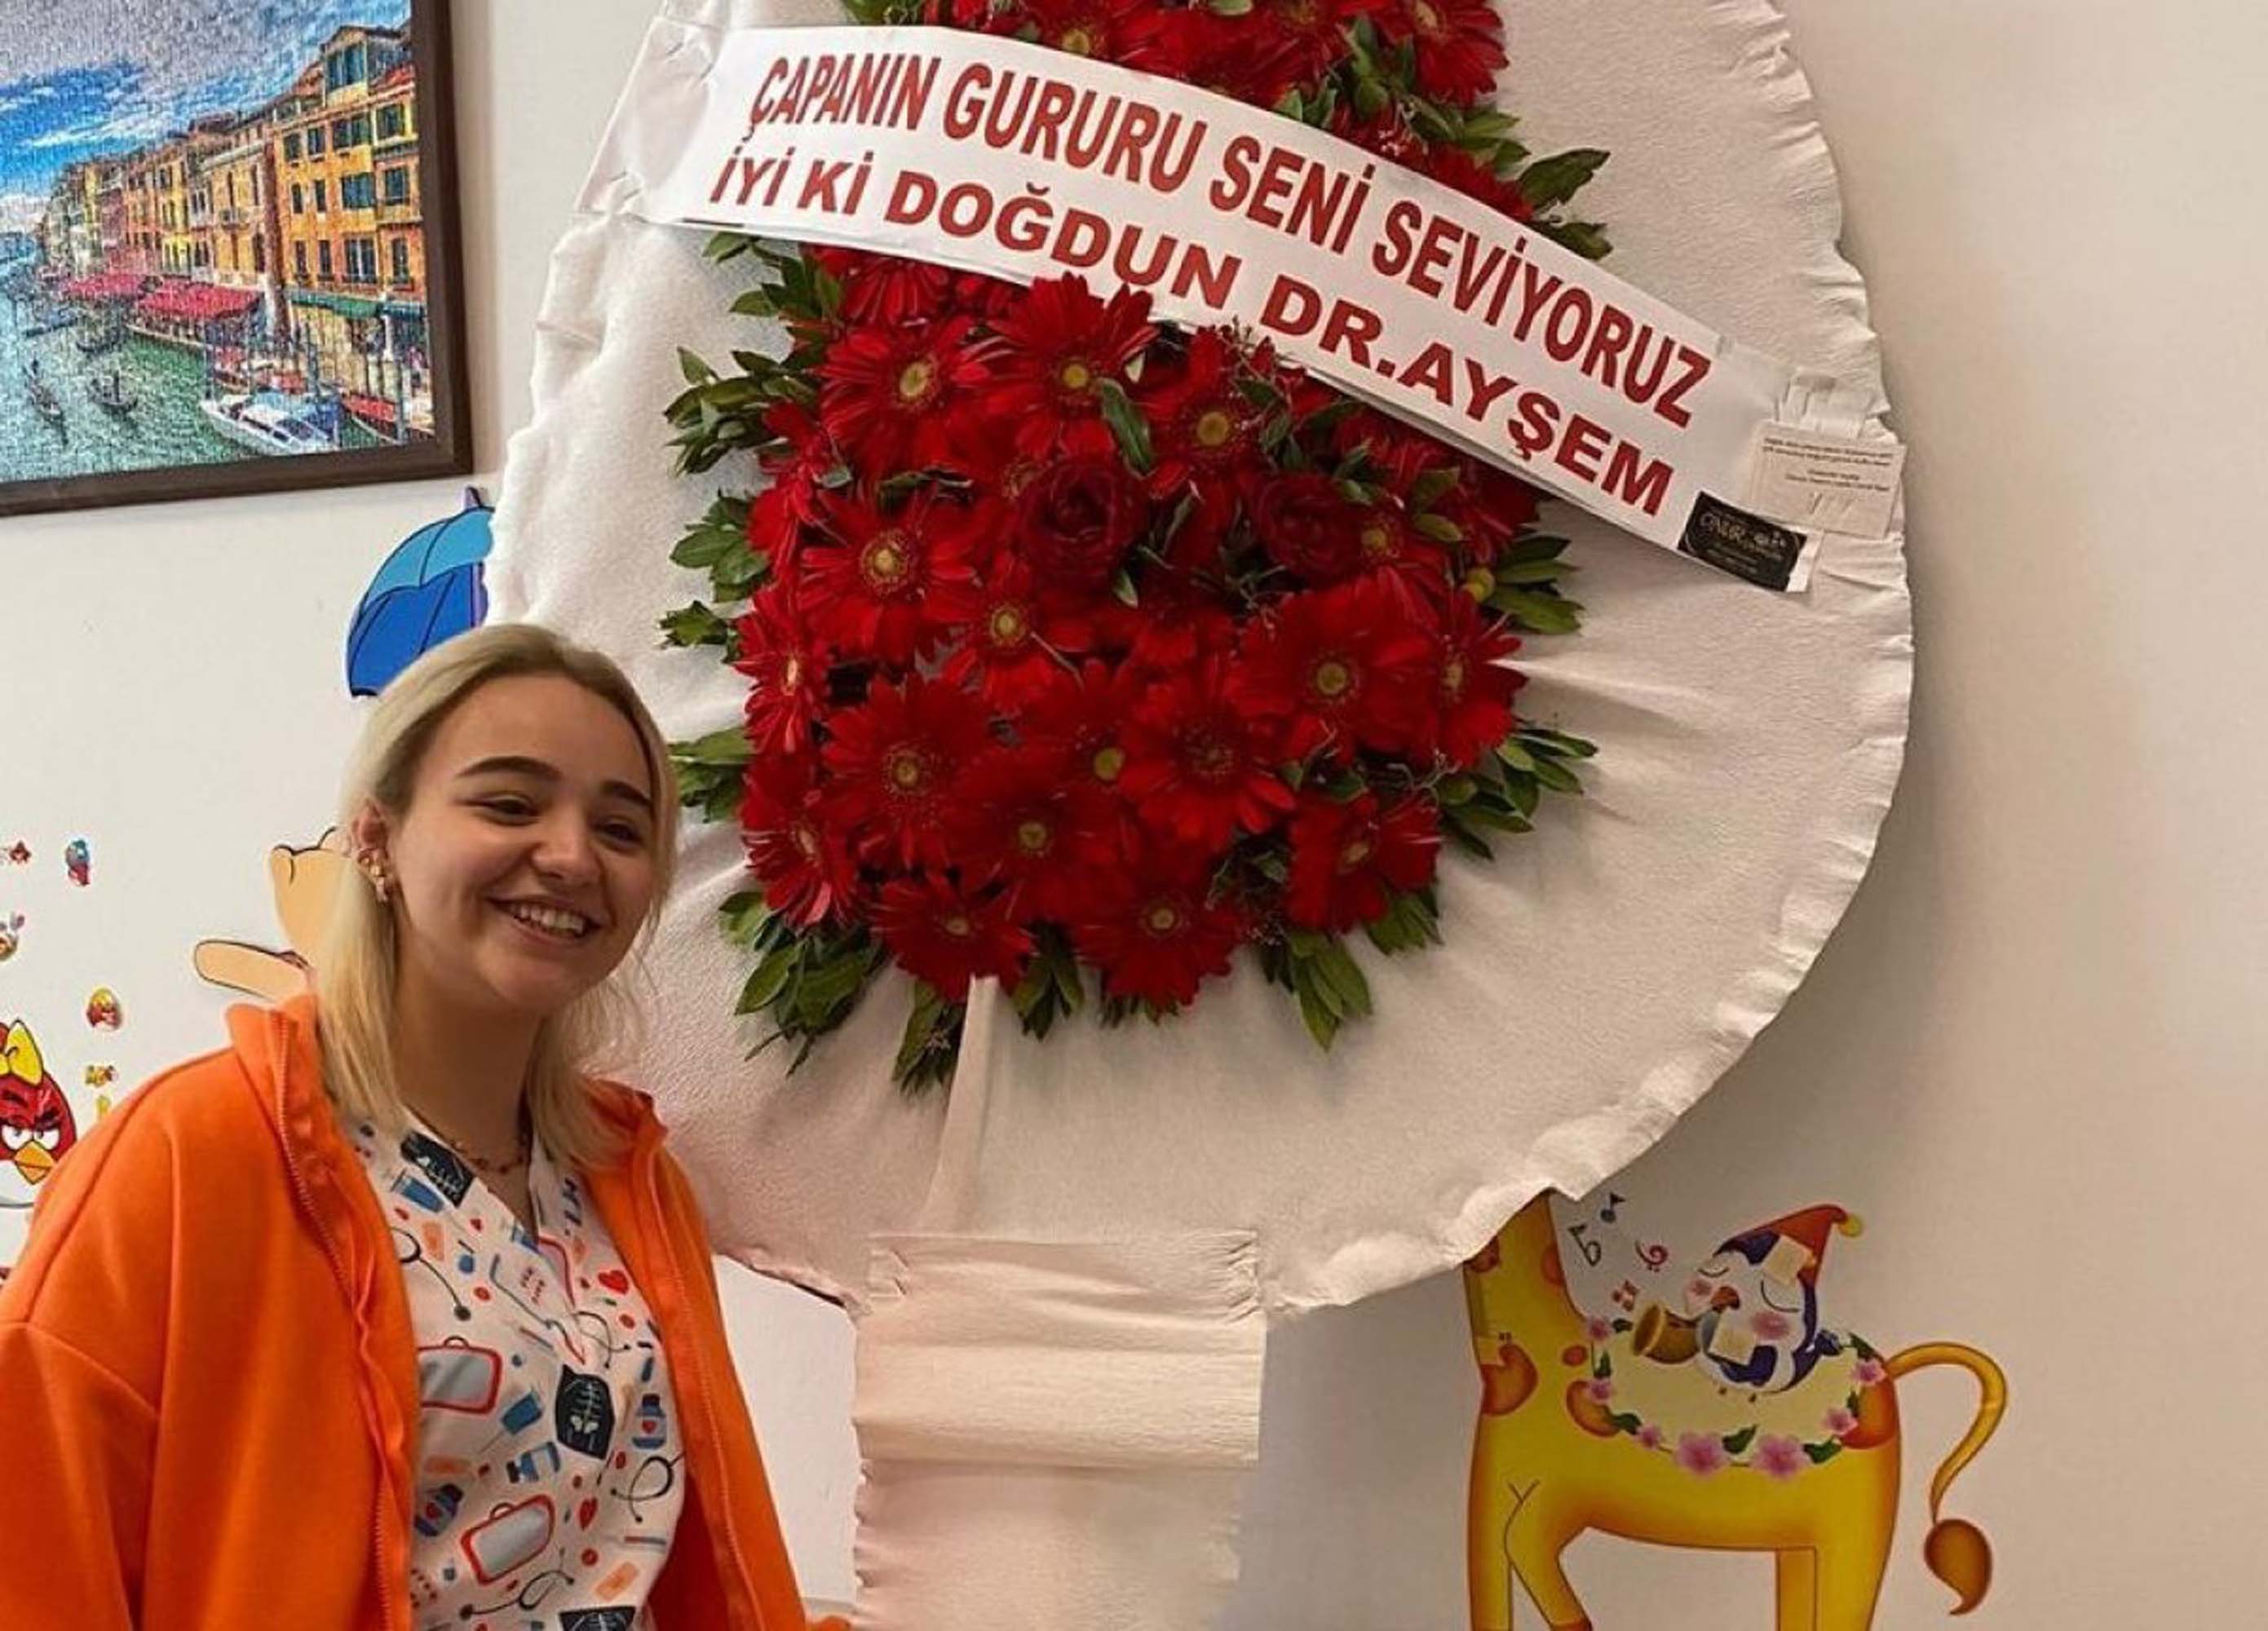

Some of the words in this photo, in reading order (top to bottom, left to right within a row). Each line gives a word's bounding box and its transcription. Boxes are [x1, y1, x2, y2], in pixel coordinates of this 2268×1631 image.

[710, 145, 795, 206] İYİ
[796, 151, 874, 215] Kİ
[884, 181, 1242, 309] DOĞDUN
[1259, 274, 1674, 516] DR.AYŞEM
[741, 53, 941, 142] ÇAPANIN
[943, 63, 1207, 192] GURURU
[1209, 135, 1376, 254] SENİ
[1372, 200, 1711, 428] SEVİYORUZ
